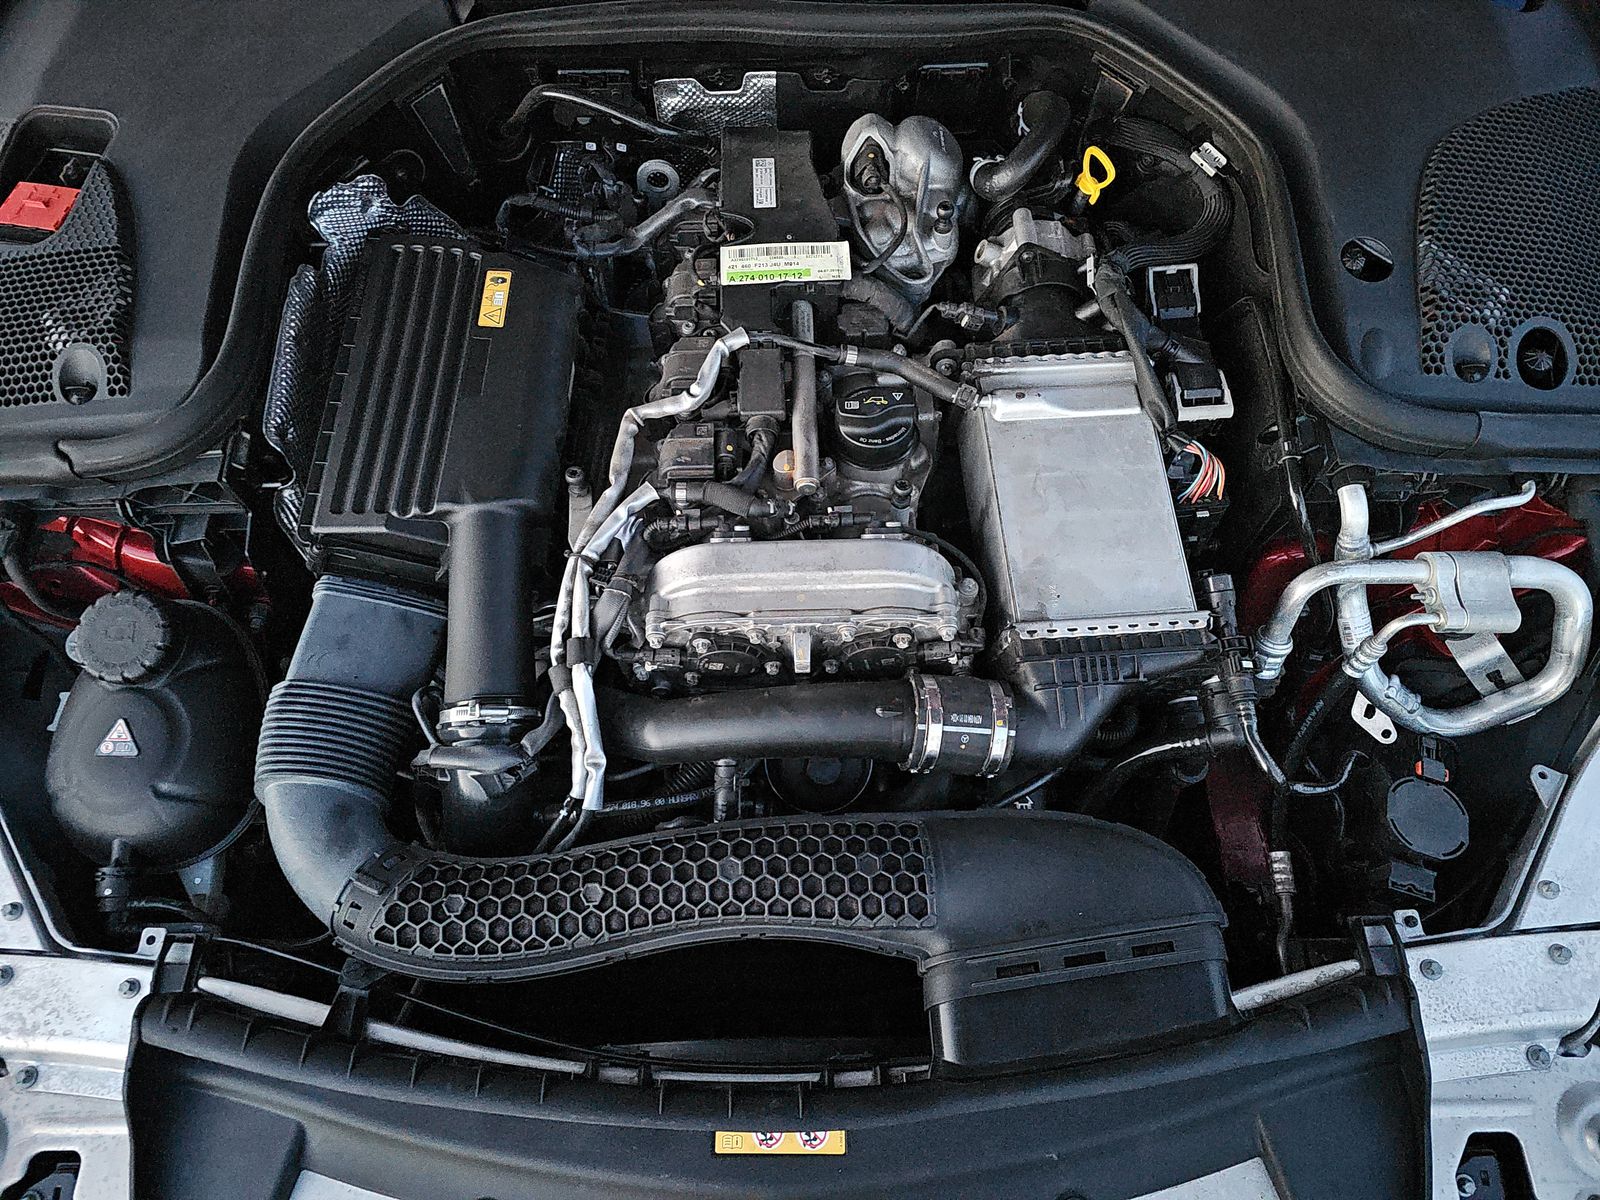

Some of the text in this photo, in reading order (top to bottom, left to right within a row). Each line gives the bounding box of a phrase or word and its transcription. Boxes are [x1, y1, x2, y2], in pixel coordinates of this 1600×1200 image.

[728, 271, 803, 283] A 274 010 17 12
